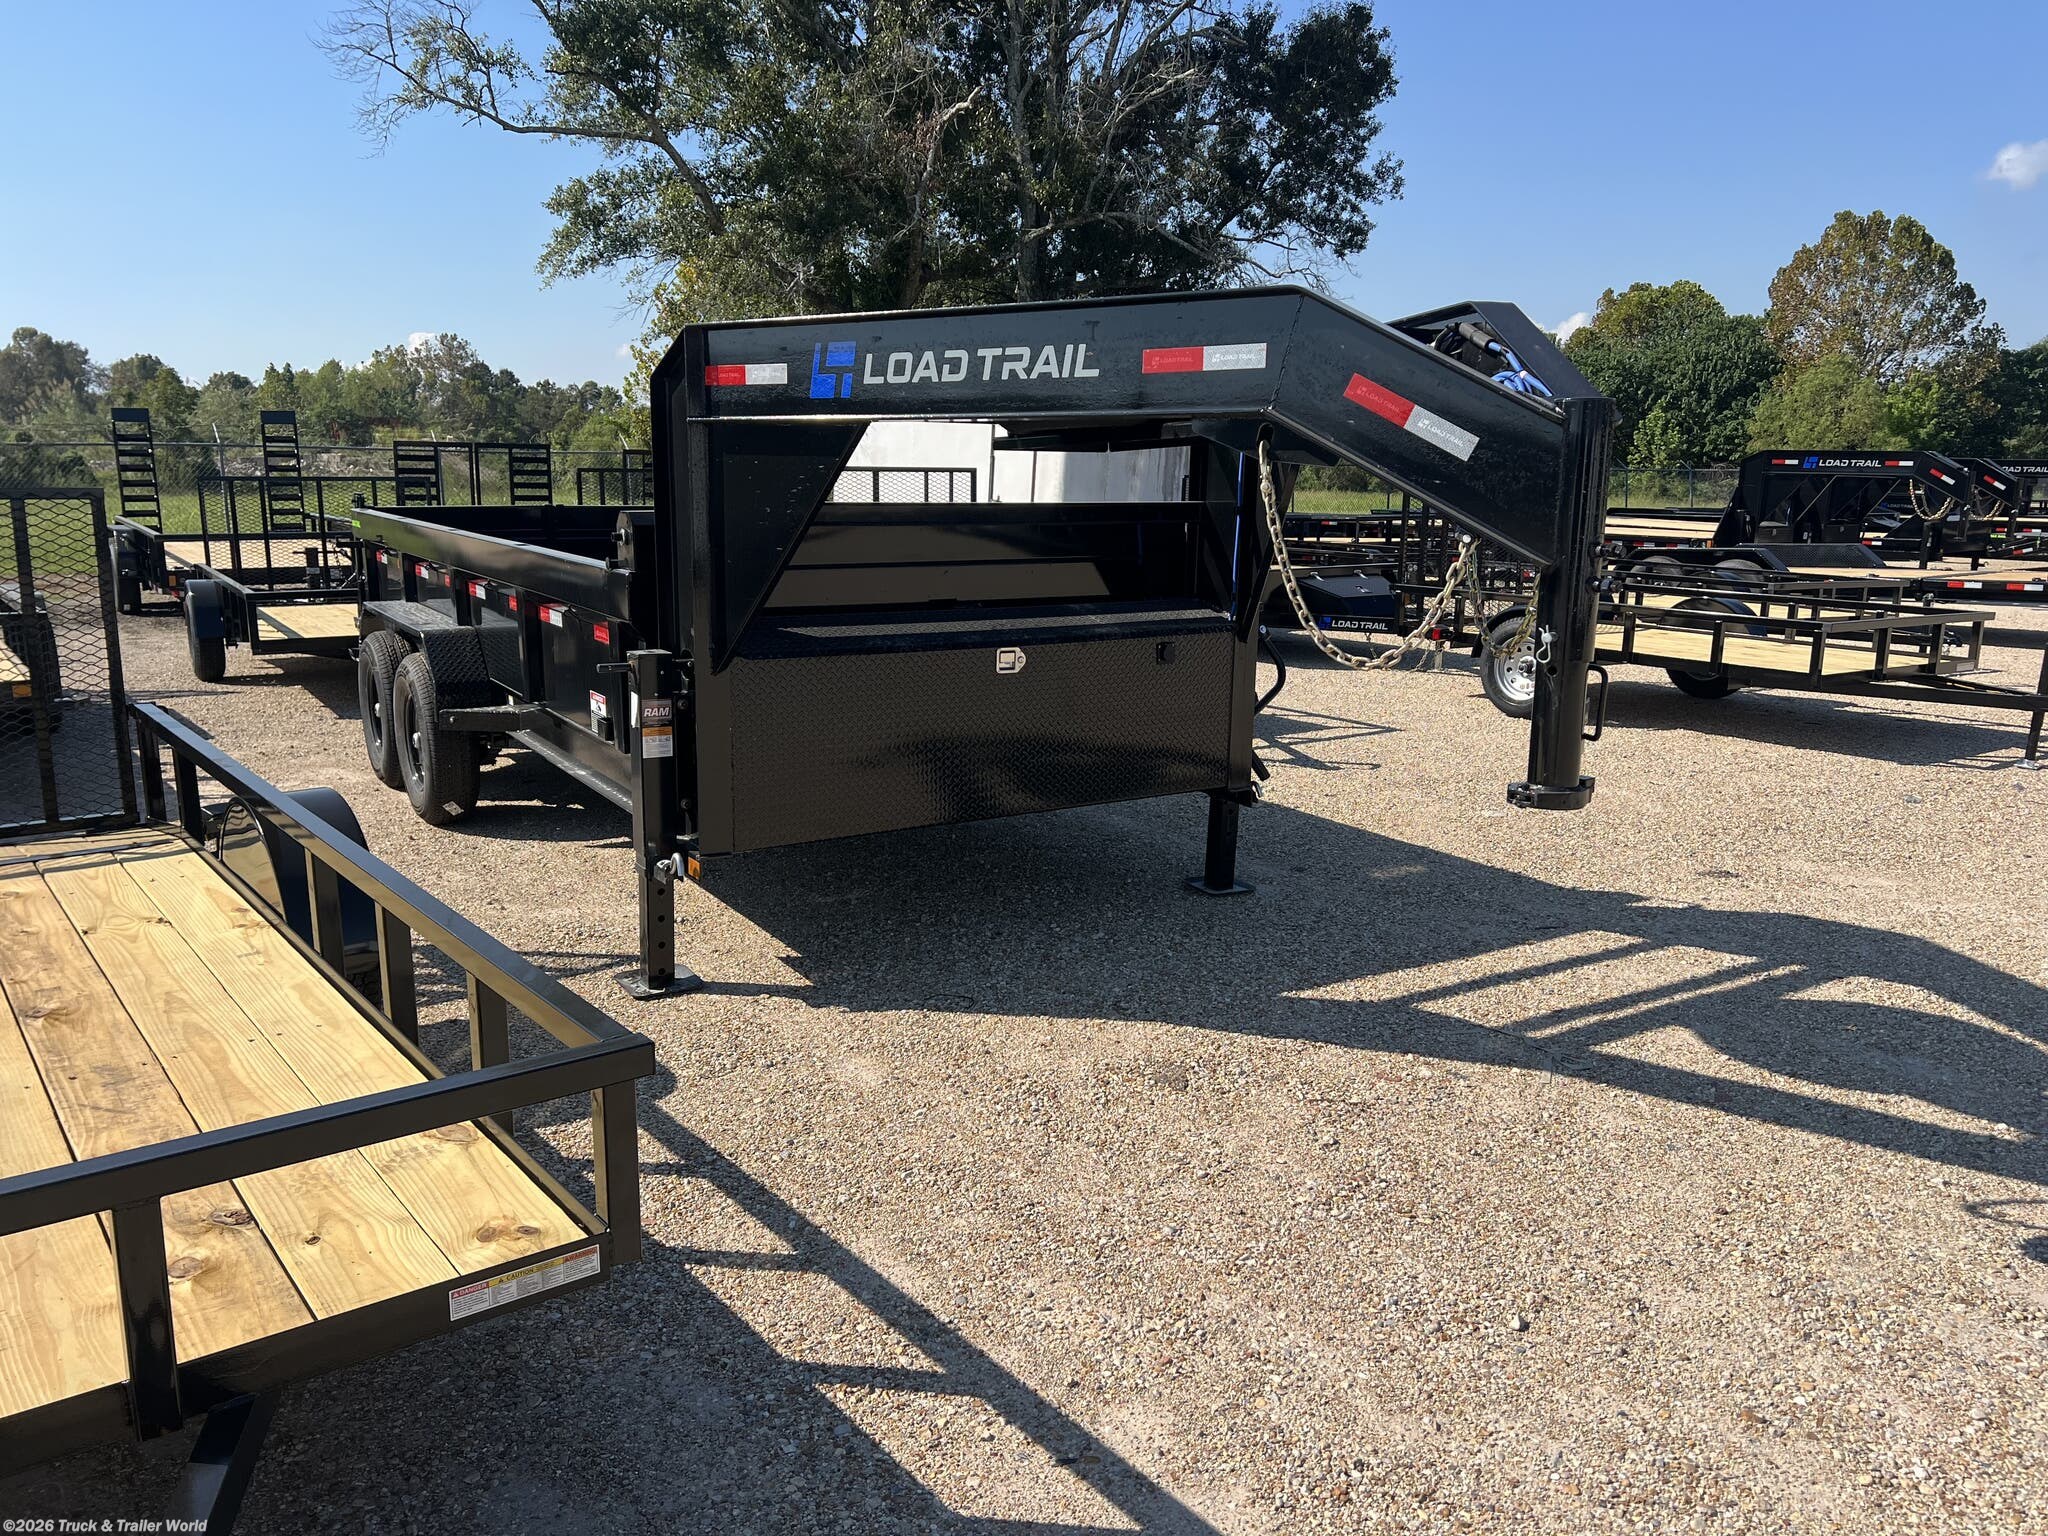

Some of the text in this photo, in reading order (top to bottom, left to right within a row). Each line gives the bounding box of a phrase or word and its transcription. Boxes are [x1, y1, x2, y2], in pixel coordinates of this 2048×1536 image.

[863, 343, 1100, 385] LOAD TRAIL
[1819, 459, 1882, 468] LOAD TRAIL
[1331, 620, 1388, 630] LOAD TRAIL
[643, 707, 670, 718] RAM
[506, 1268, 534, 1281] CAUTION
[459, 1283, 488, 1296] DANGER
